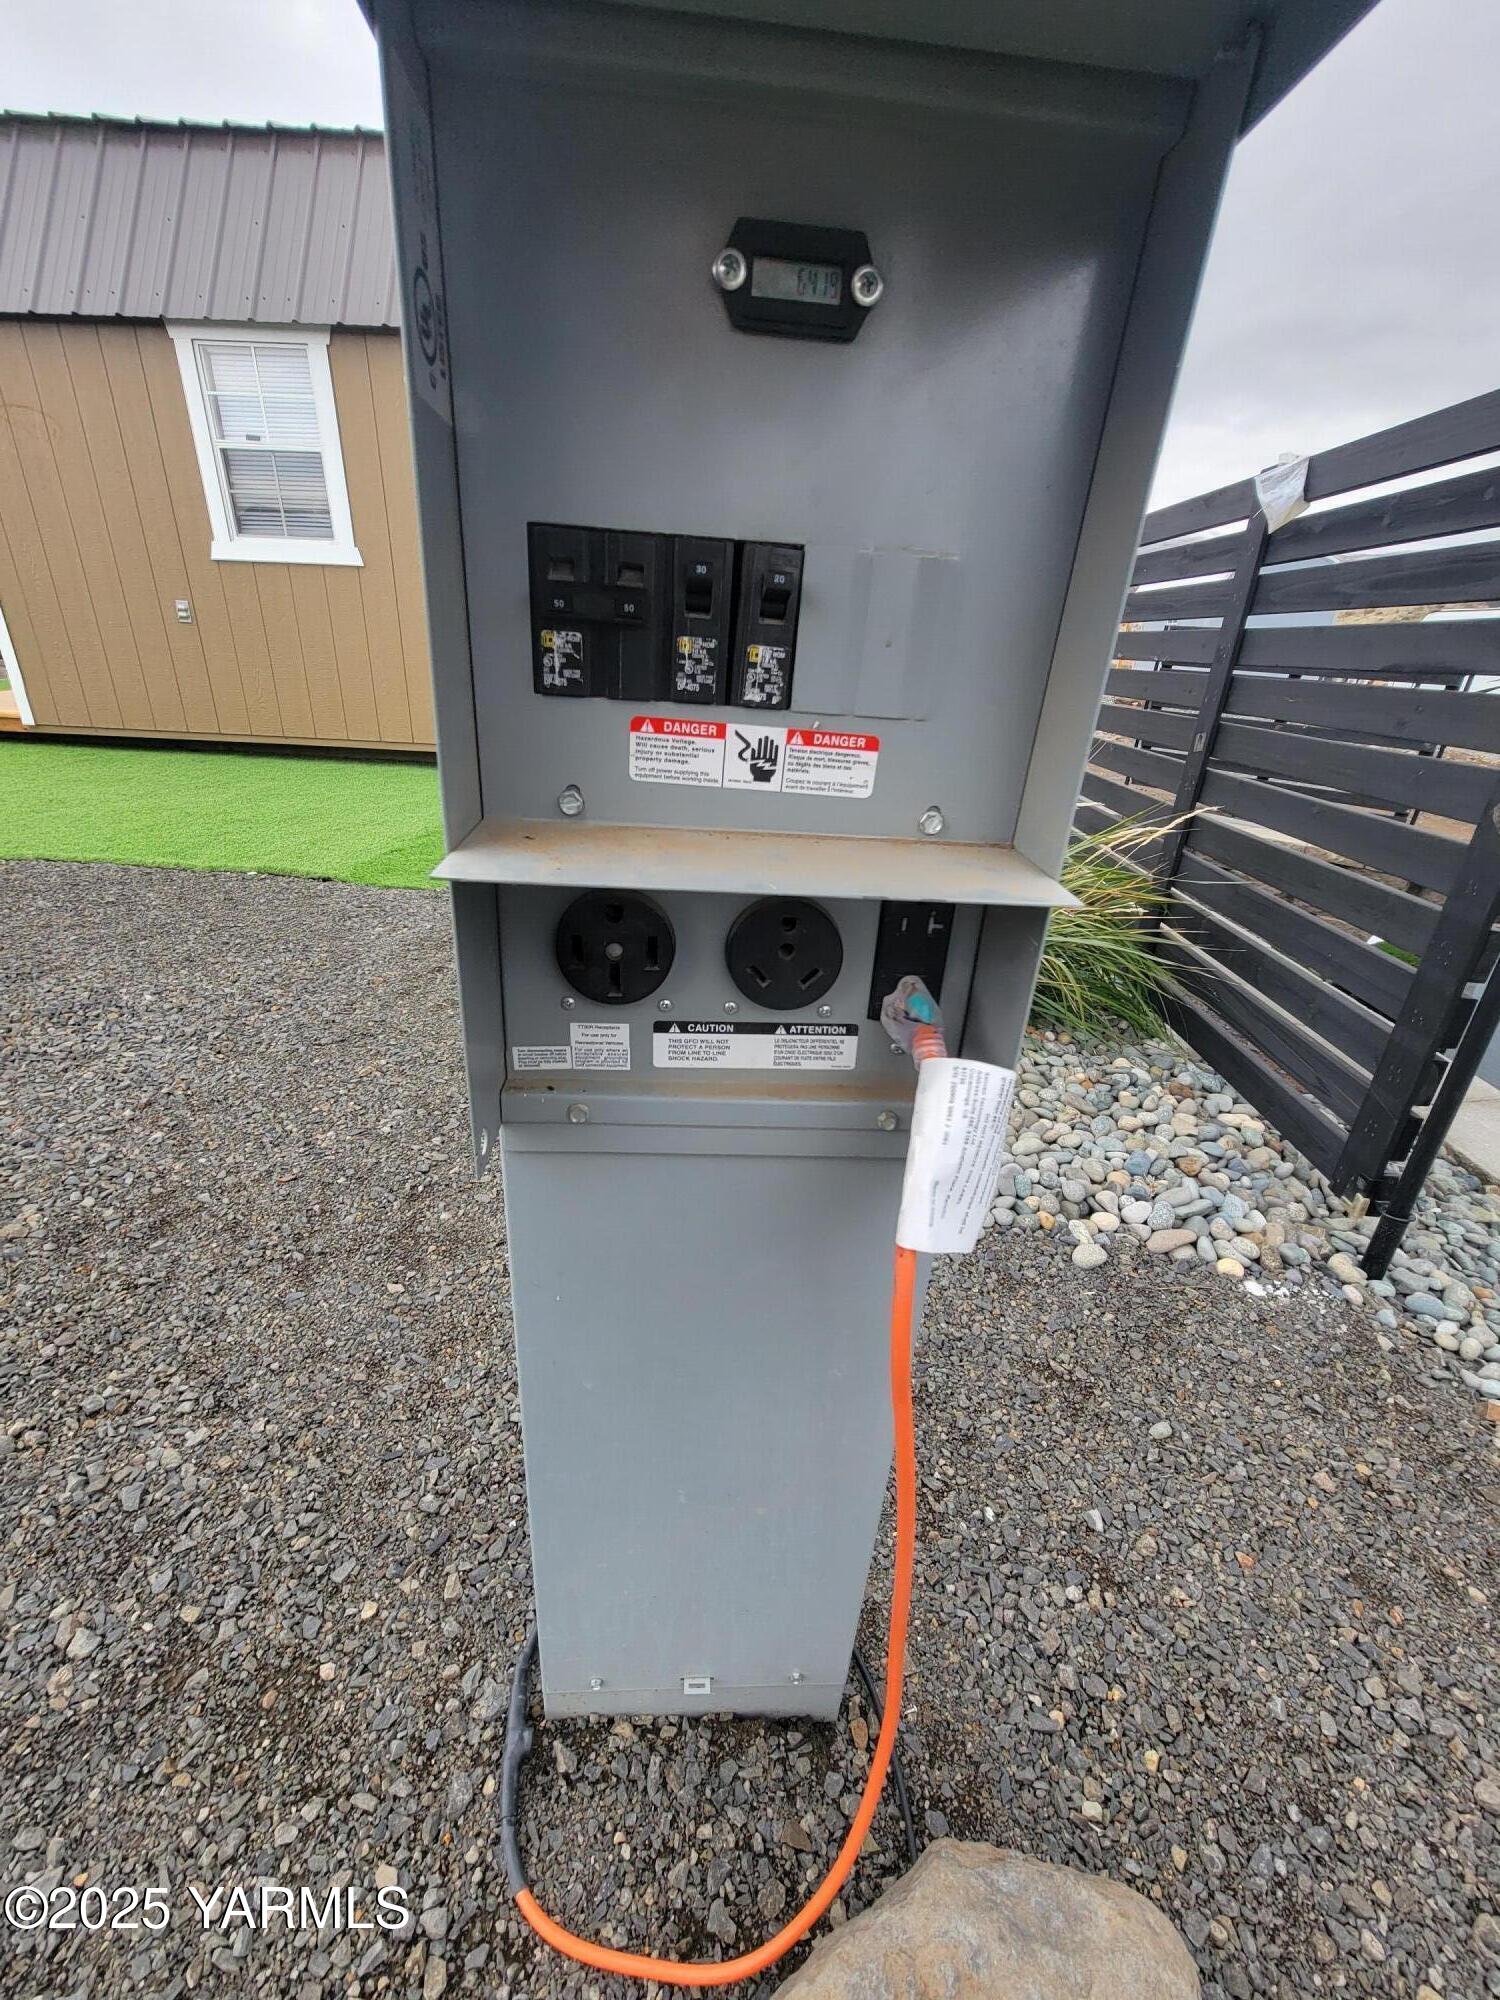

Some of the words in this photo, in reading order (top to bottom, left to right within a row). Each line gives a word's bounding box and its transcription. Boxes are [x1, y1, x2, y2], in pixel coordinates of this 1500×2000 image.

[696, 565, 706, 574] 30
[773, 574, 785, 583] 20
[553, 599, 565, 608] 50
[664, 722, 717, 736] DANGER
[813, 734, 866, 748] DANGER
[687, 1024, 734, 1032] CAUTION
[790, 1026, 847, 1034] ATTENTION
